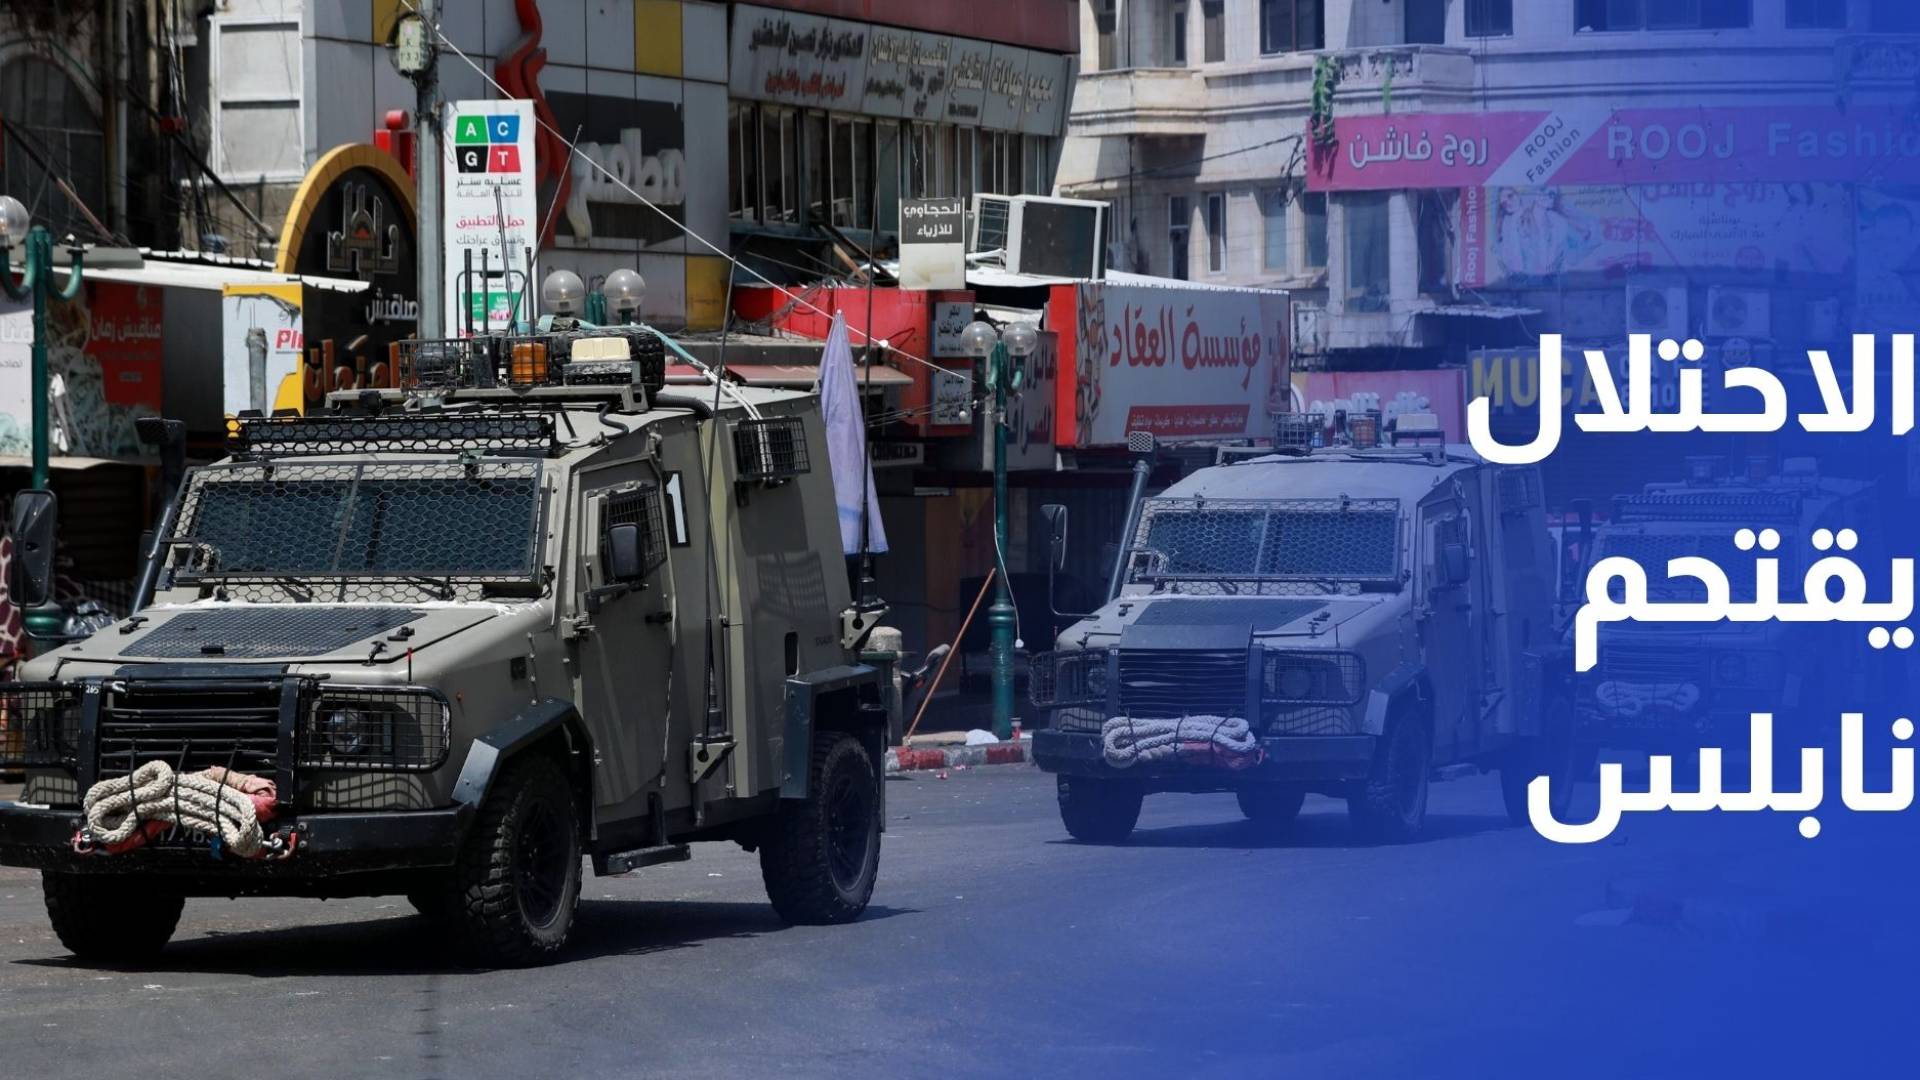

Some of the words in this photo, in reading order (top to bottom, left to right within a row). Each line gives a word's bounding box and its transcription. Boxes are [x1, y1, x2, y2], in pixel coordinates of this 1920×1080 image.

[1350, 125, 1433, 169] فاشن
[1440, 133, 1489, 167] روج
[1523, 116, 1565, 157] ROOJ
[1525, 126, 1581, 183] Fashion
[1607, 123, 1736, 160] ROOJ
[566, 128, 687, 246] مطعم
[456, 213, 500, 230] التطبيق
[903, 203, 961, 219] الحجاوي
[1464, 246, 1479, 284] Rooj
[1110, 303, 1175, 367] العقاد
[1182, 304, 1261, 392] مؤسسة
[673, 473, 687, 543] 1
